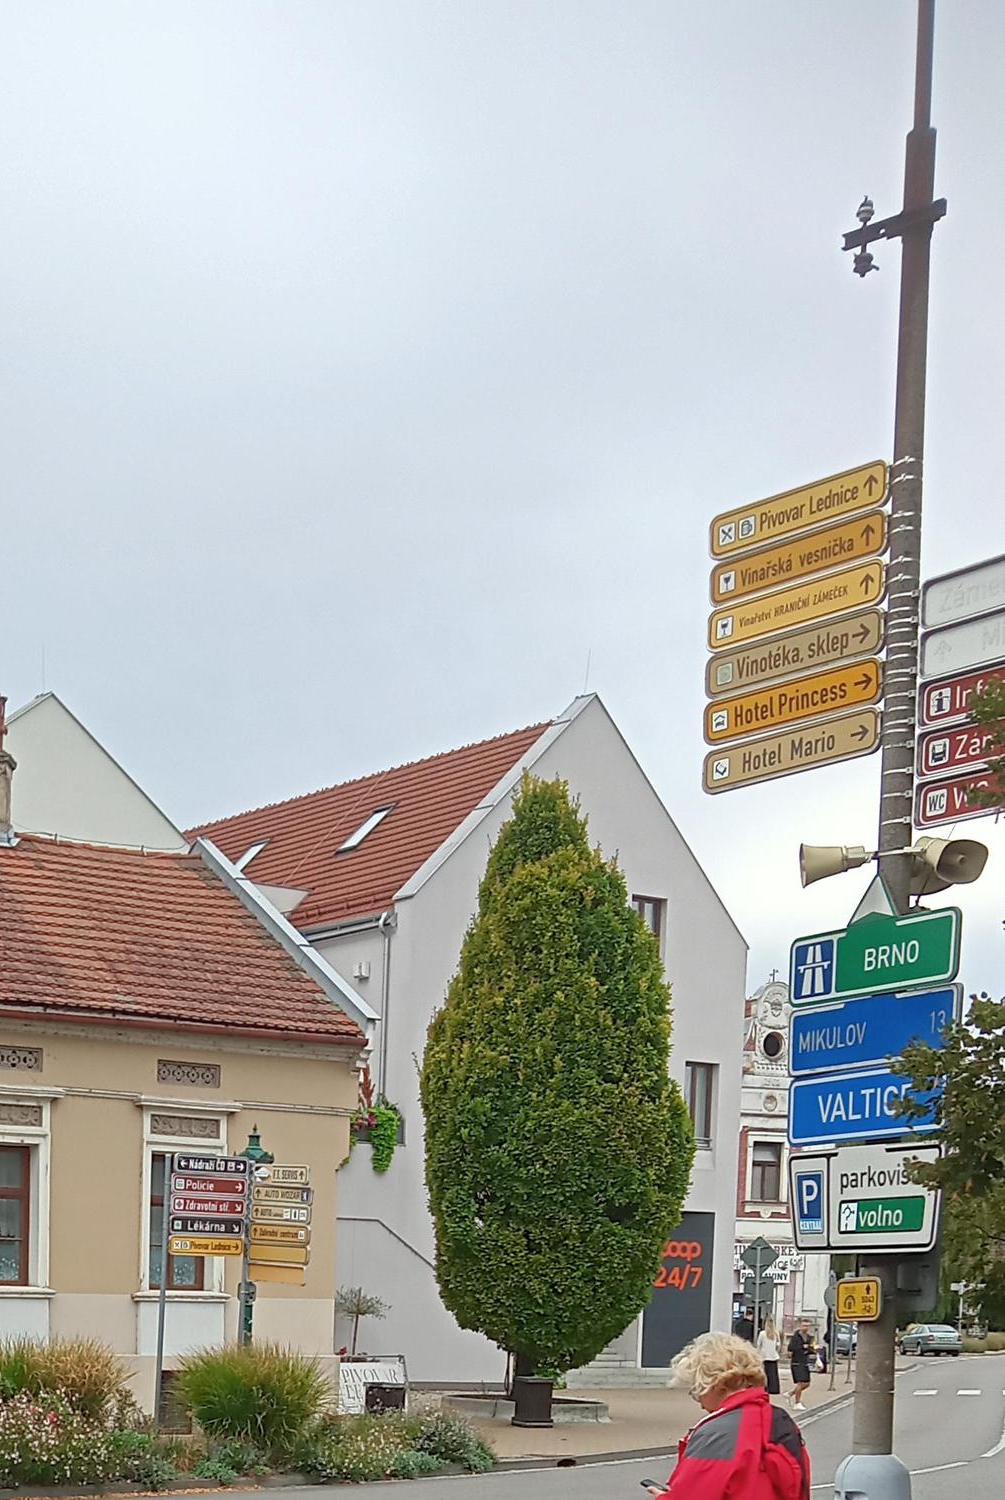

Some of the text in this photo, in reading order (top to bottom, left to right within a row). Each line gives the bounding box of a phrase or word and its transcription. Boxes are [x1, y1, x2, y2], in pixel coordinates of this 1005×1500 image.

[759, 485, 859, 532] Pivovar Lednice
[740, 536, 854, 587] Vinařská vesnička
[739, 585, 848, 628] Vinařství HRANIČNÍ ZÁMEČEK
[737, 632, 849, 679] Vinotéka, sklep
[734, 682, 847, 727] Hotel Princess
[742, 731, 835, 773] Hotel Mario
[863, 940, 920, 972] BRNO
[798, 1009, 946, 1054] MIKULOV 13
[189, 1158, 215, 1170] Nádraží
[185, 1179, 214, 1191] Policie
[801, 1179, 818, 1214] P
[185, 1199, 218, 1211] Zdravotní
[858, 1204, 903, 1228] volno
[187, 1220, 226, 1232] Lékárna
[653, 1264, 702, 1290] 24/7
